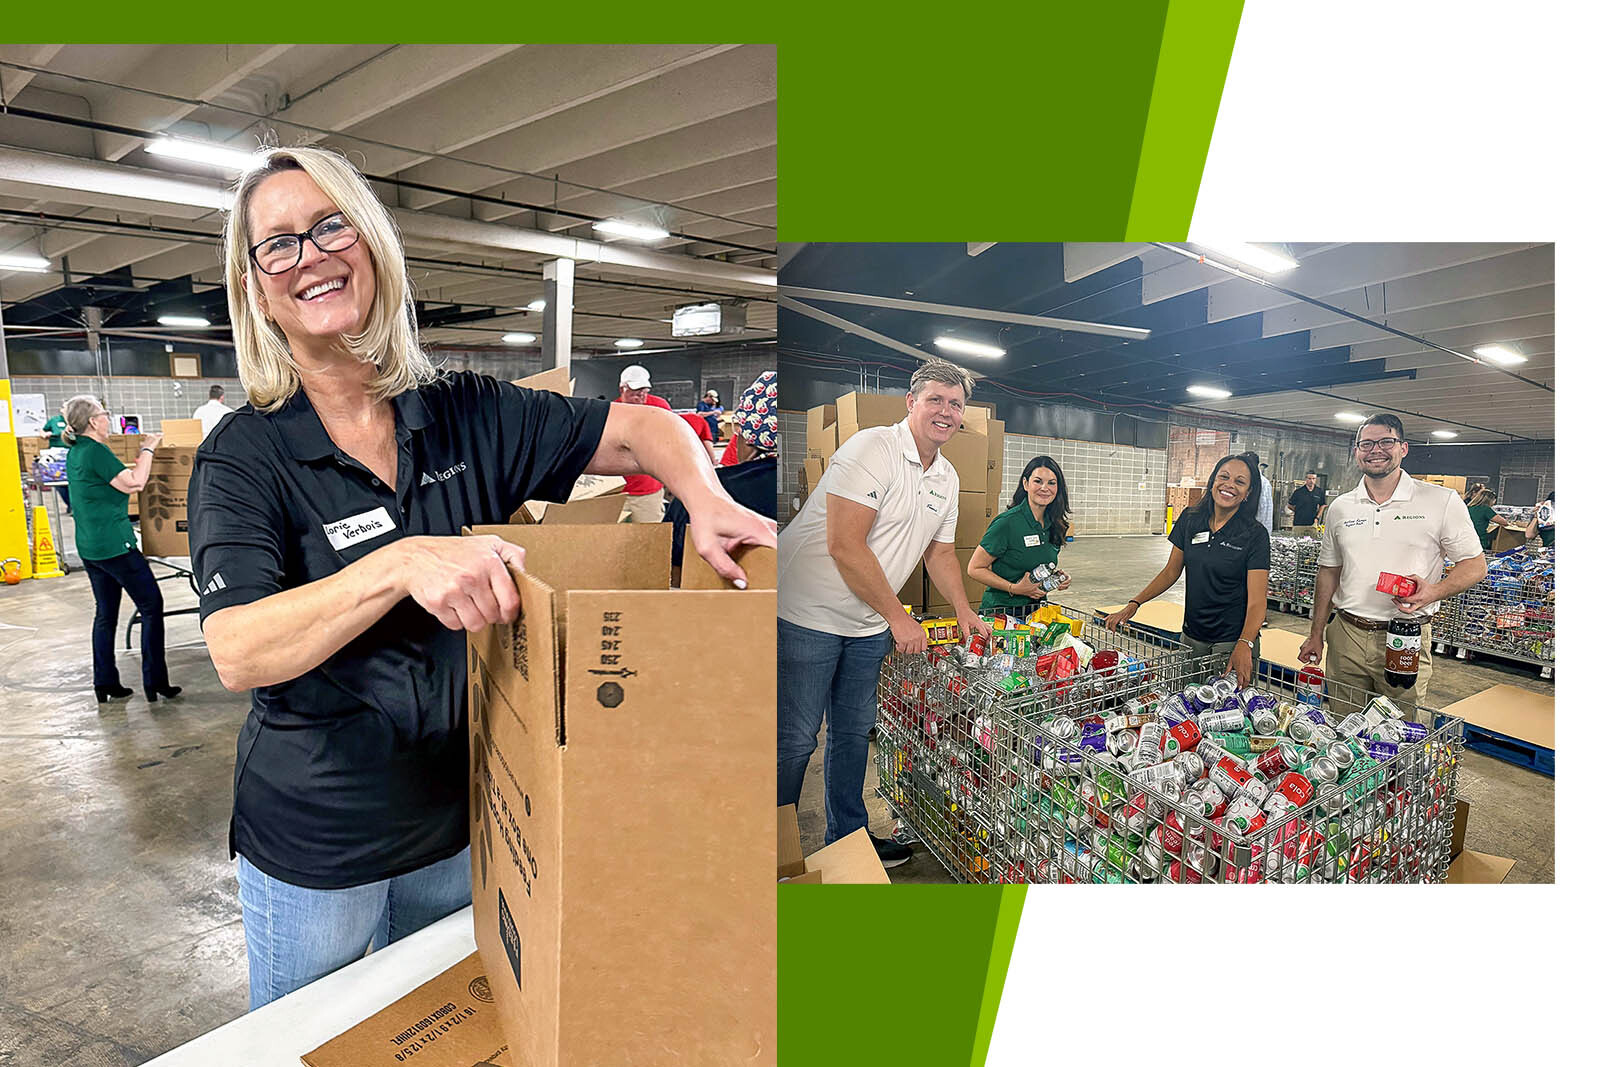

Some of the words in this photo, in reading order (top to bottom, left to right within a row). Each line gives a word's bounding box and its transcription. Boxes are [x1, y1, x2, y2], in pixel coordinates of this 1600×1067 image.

[1289, 782, 1305, 799] cola
[463, 1006, 477, 1017] 16
[449, 1012, 468, 1025] 1/2
[425, 1028, 443, 1042] 1/2
[410, 1041, 424, 1053] 12
[394, 1047, 413, 1062] 5/8
